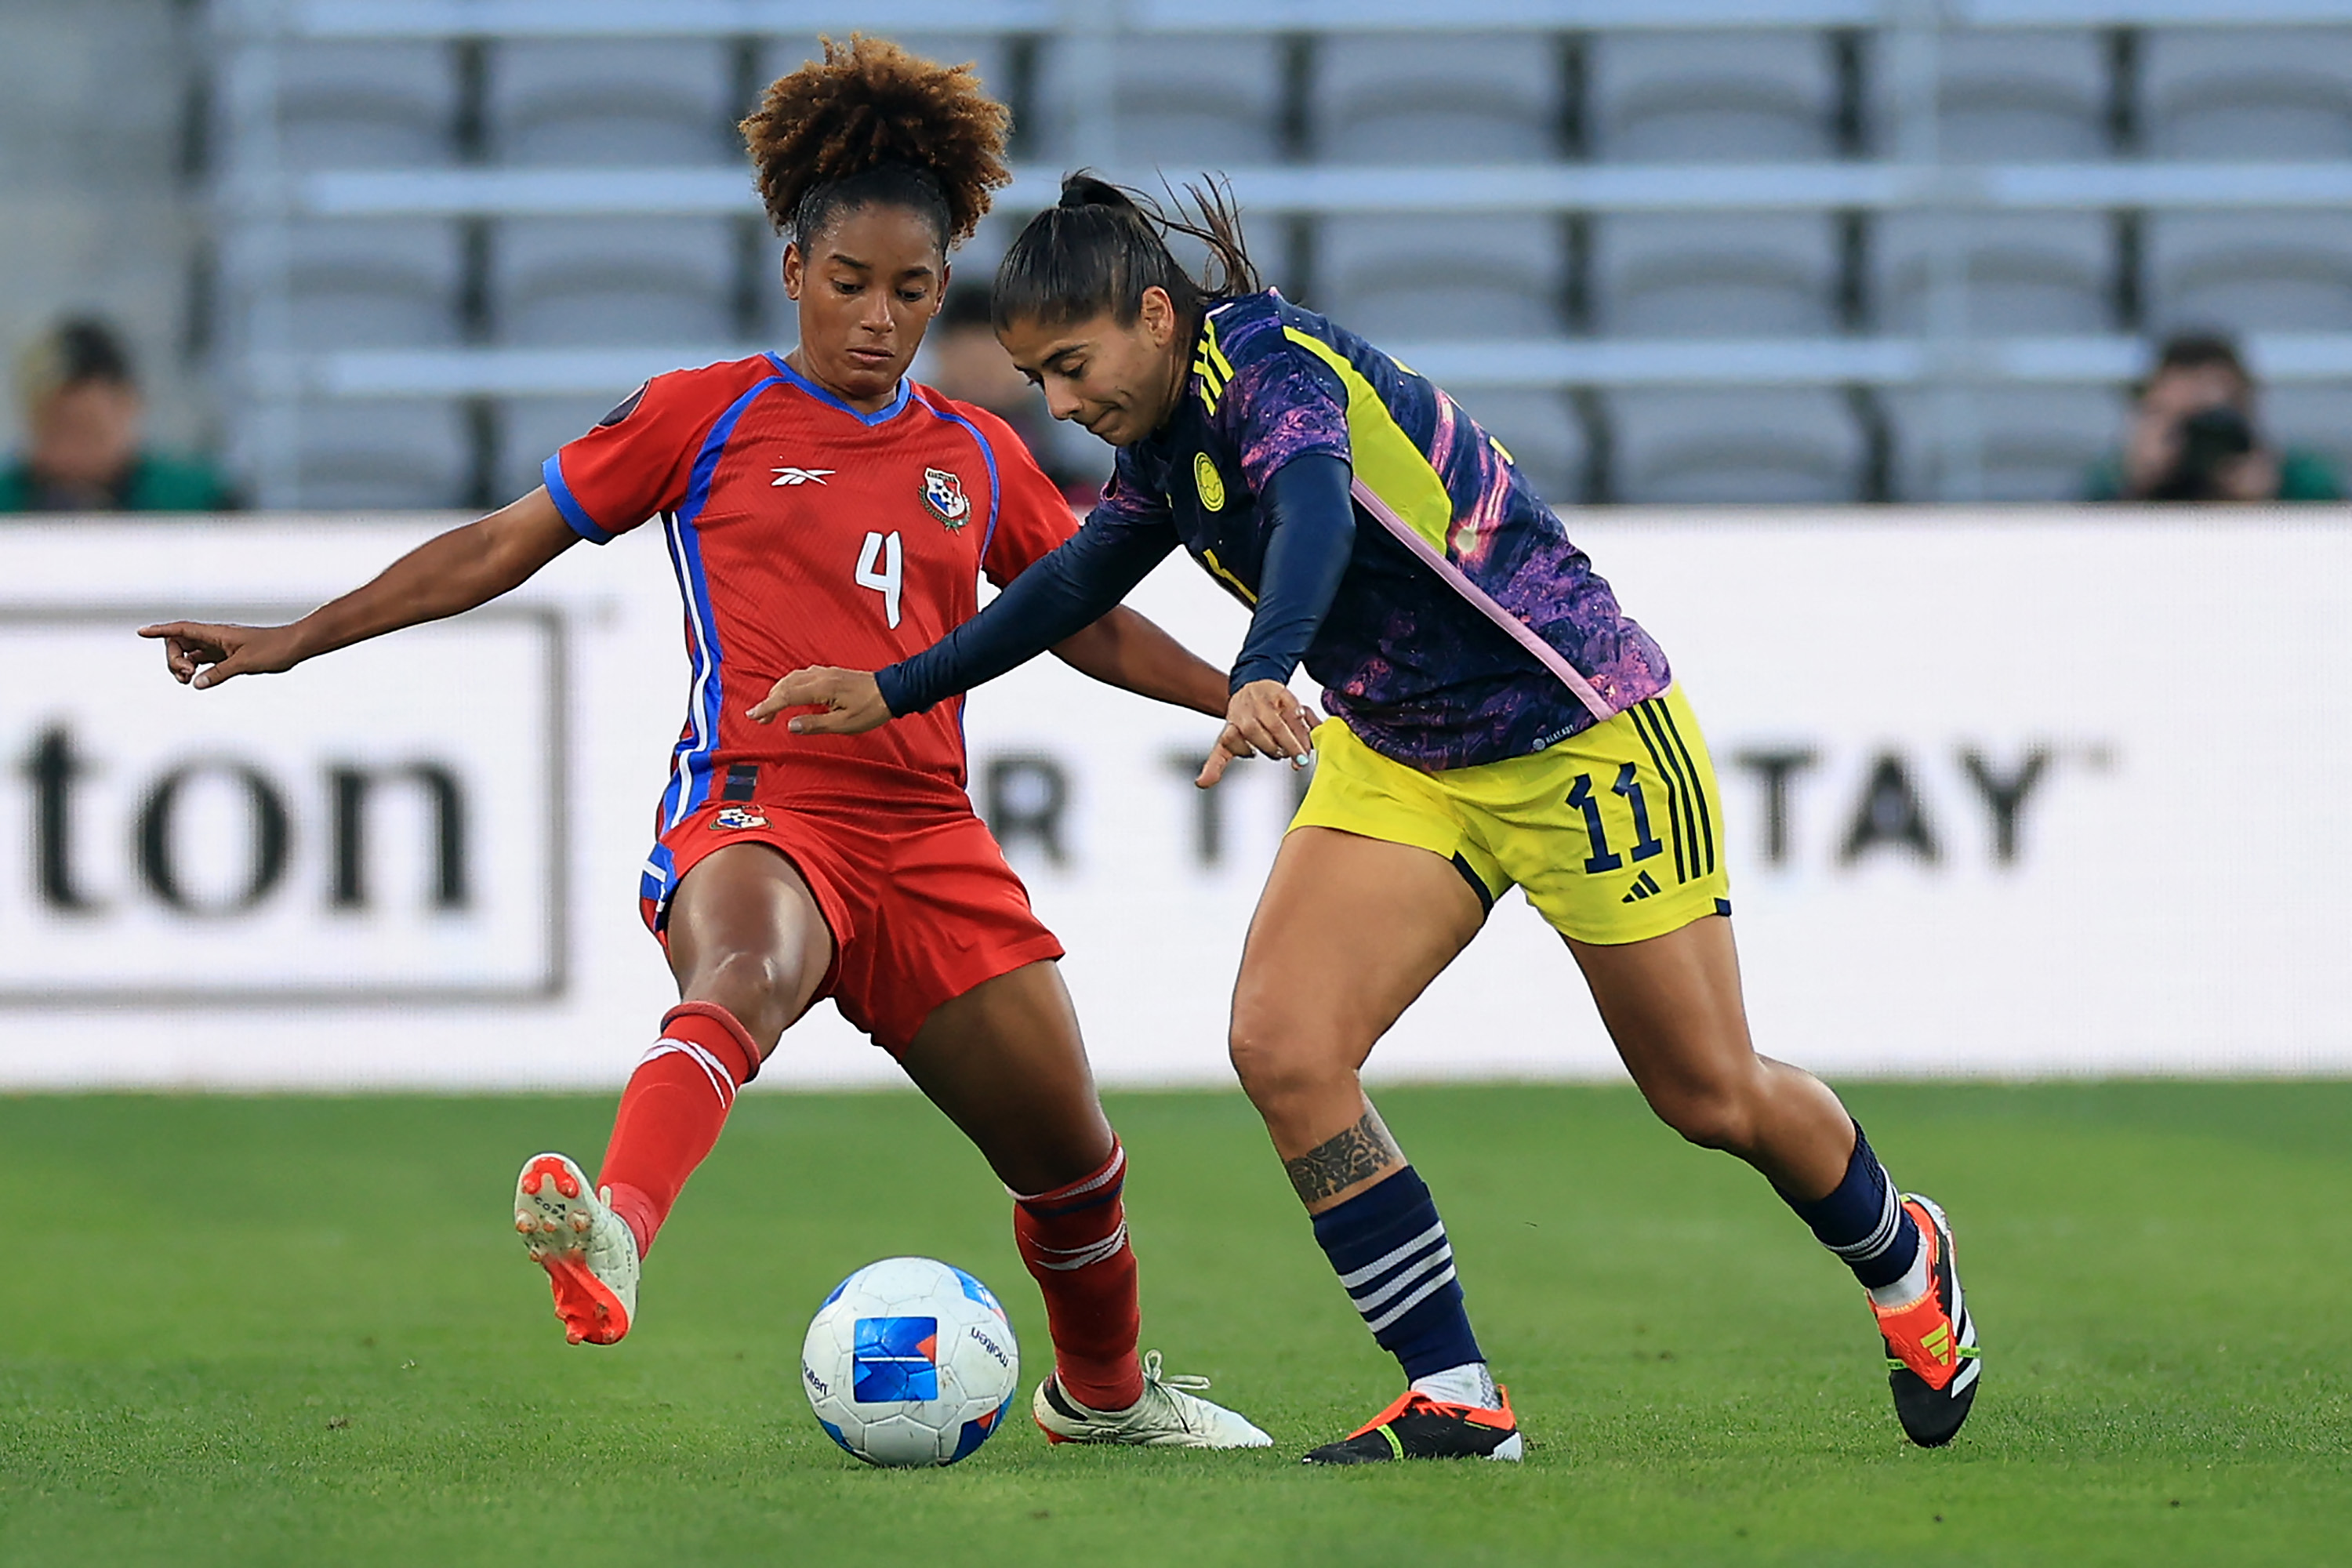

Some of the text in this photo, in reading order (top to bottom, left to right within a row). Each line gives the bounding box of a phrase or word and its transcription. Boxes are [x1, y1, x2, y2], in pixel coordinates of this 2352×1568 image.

[855, 530, 902, 630] 4
[12, 721, 474, 917] ton
[1565, 761, 1663, 874] 11
[1730, 745, 2053, 867] TAY
[971, 1327, 1009, 1368] molten
